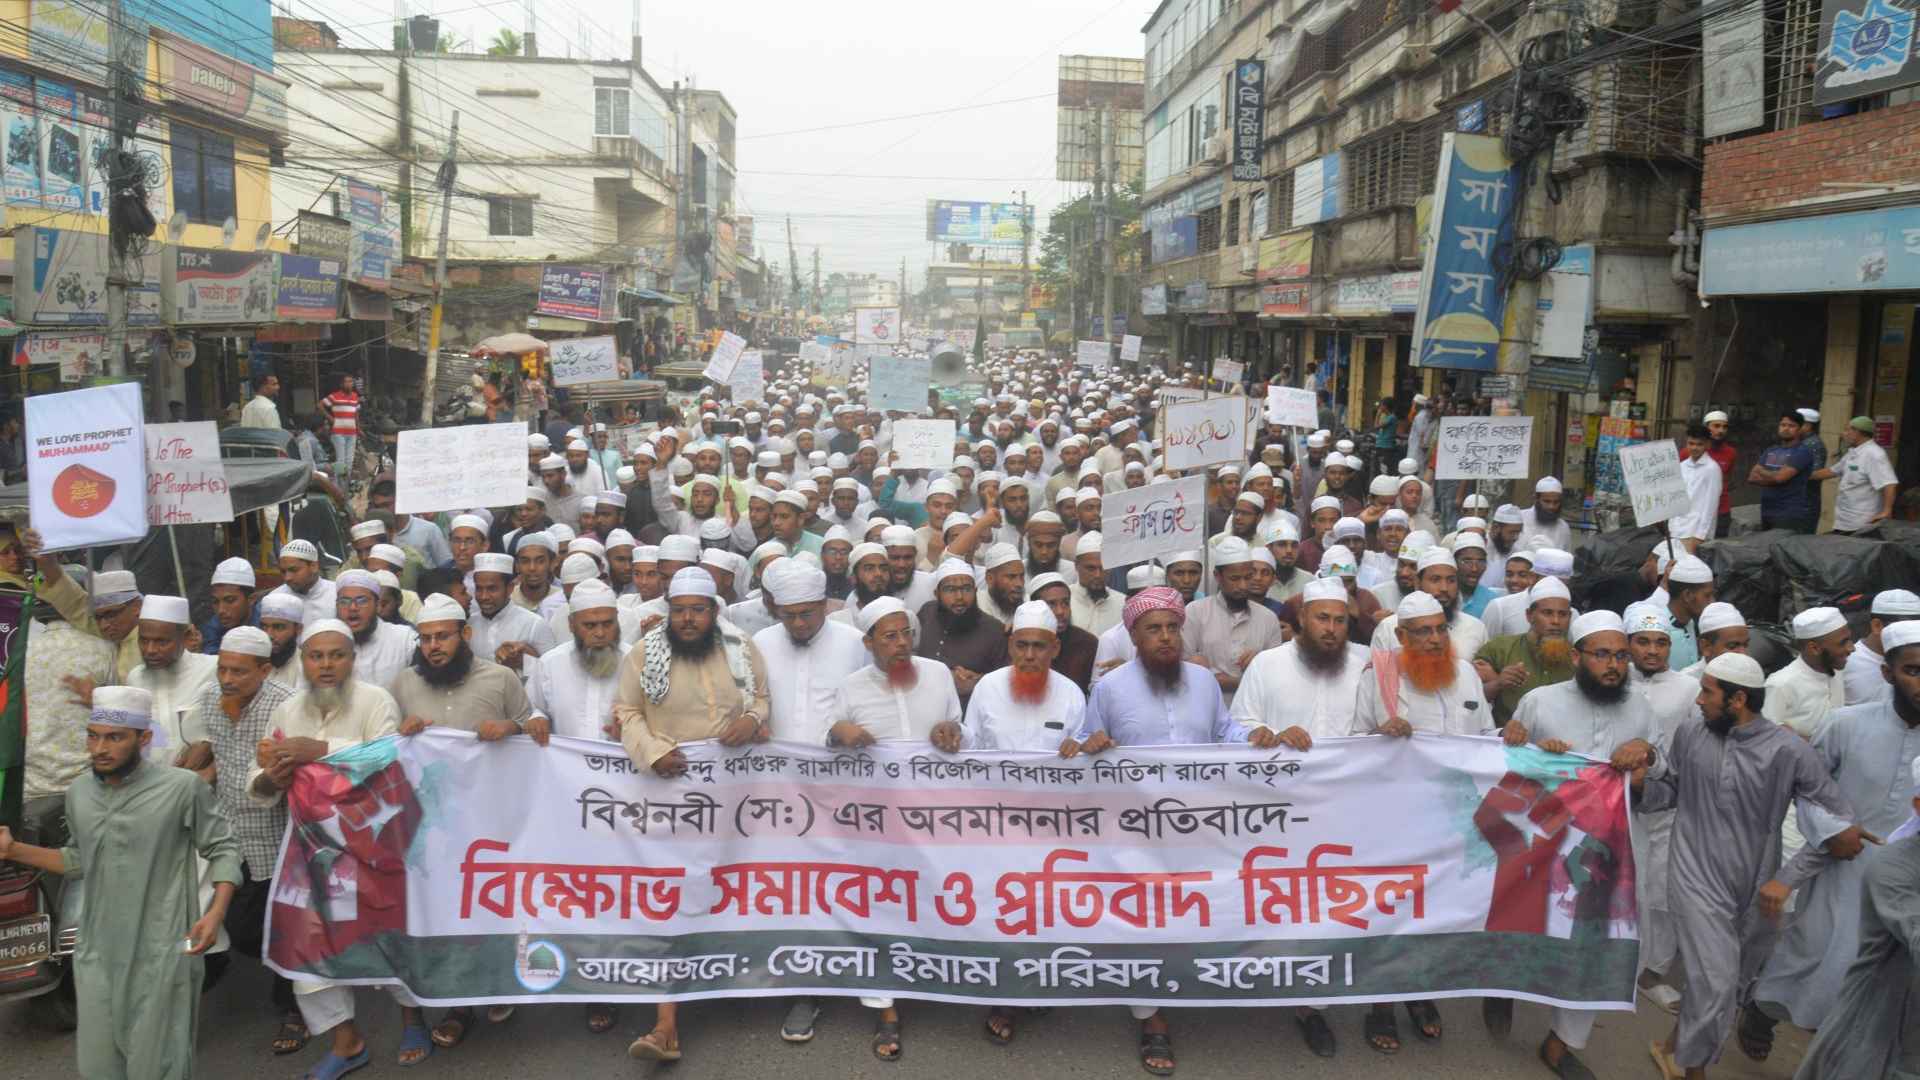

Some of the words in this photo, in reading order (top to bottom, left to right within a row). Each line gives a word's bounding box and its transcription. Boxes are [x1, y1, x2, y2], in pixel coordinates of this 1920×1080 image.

[36, 435, 53, 447] WE
[55, 433, 81, 445] LOVE
[83, 427, 133, 442] PROPHET
[38, 442, 111, 459] MUHAMMAD
[724, 752, 787, 776] ধর্মগুরু
[796, 752, 875, 779] রামগিরি
[882, 762, 901, 779] ও
[910, 756, 991, 781] বিজেপি
[1000, 759, 1085, 785] বিধায়ক
[1092, 758, 1167, 785] নিতিশ
[1174, 762, 1228, 782] রানে
[1235, 752, 1302, 788] কর্তৃক
[576, 787, 723, 835] বিশ্বনবী
[833, 801, 889, 832] এর
[897, 801, 1105, 838] অবমাননার
[459, 839, 687, 920] বিক্ষোভ
[710, 861, 919, 923] সমাবেশ
[934, 871, 977, 927] ও
[995, 848, 1213, 937] প্রতিবাদ
[1238, 843, 1429, 931] মিছিল
[768, 945, 879, 978] জেলা
[889, 942, 1000, 987] ইমাম
